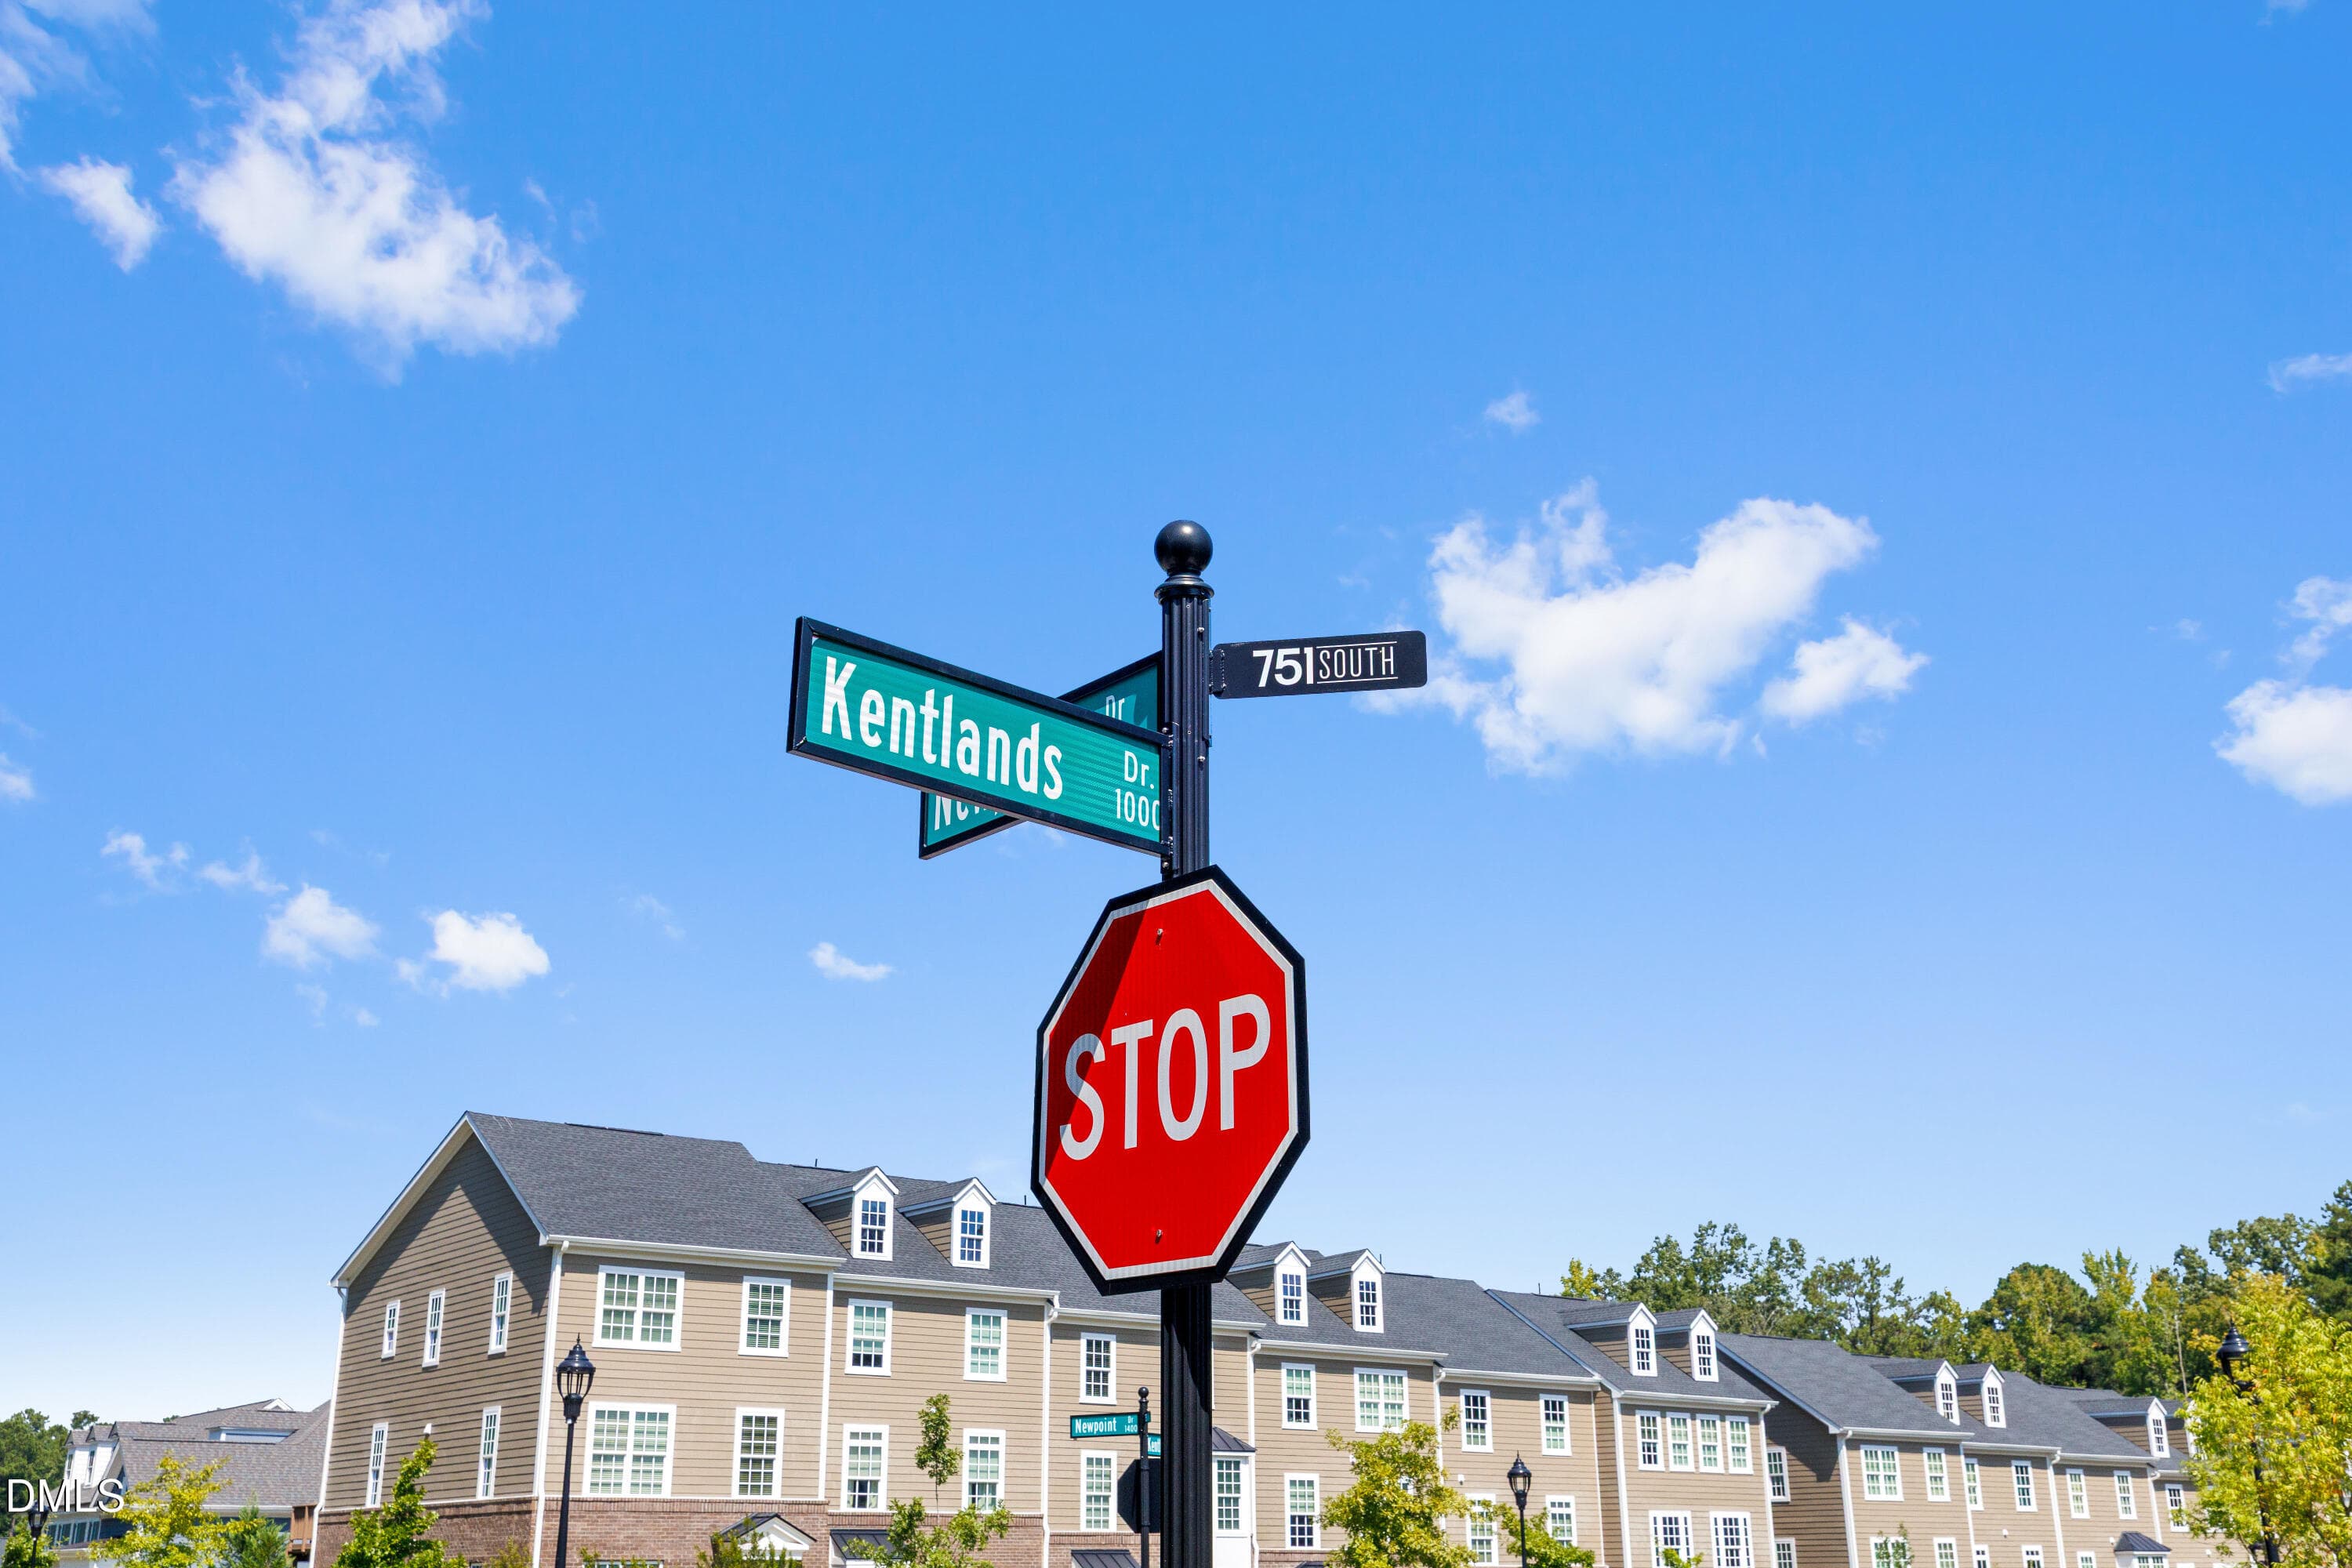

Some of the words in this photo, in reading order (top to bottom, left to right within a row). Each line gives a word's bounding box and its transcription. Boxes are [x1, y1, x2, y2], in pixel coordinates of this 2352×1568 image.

[1252, 647, 1314, 688] 751
[1319, 645, 1395, 680] SOUTH
[821, 655, 1063, 800] Kentlands
[1123, 750, 1155, 789] Dr.
[1059, 993, 1271, 1161] STOP
[1075, 1417, 1117, 1434] Newpoint
[1127, 1415, 1134, 1424] Dr
[1124, 1424, 1138, 1433] 1400
